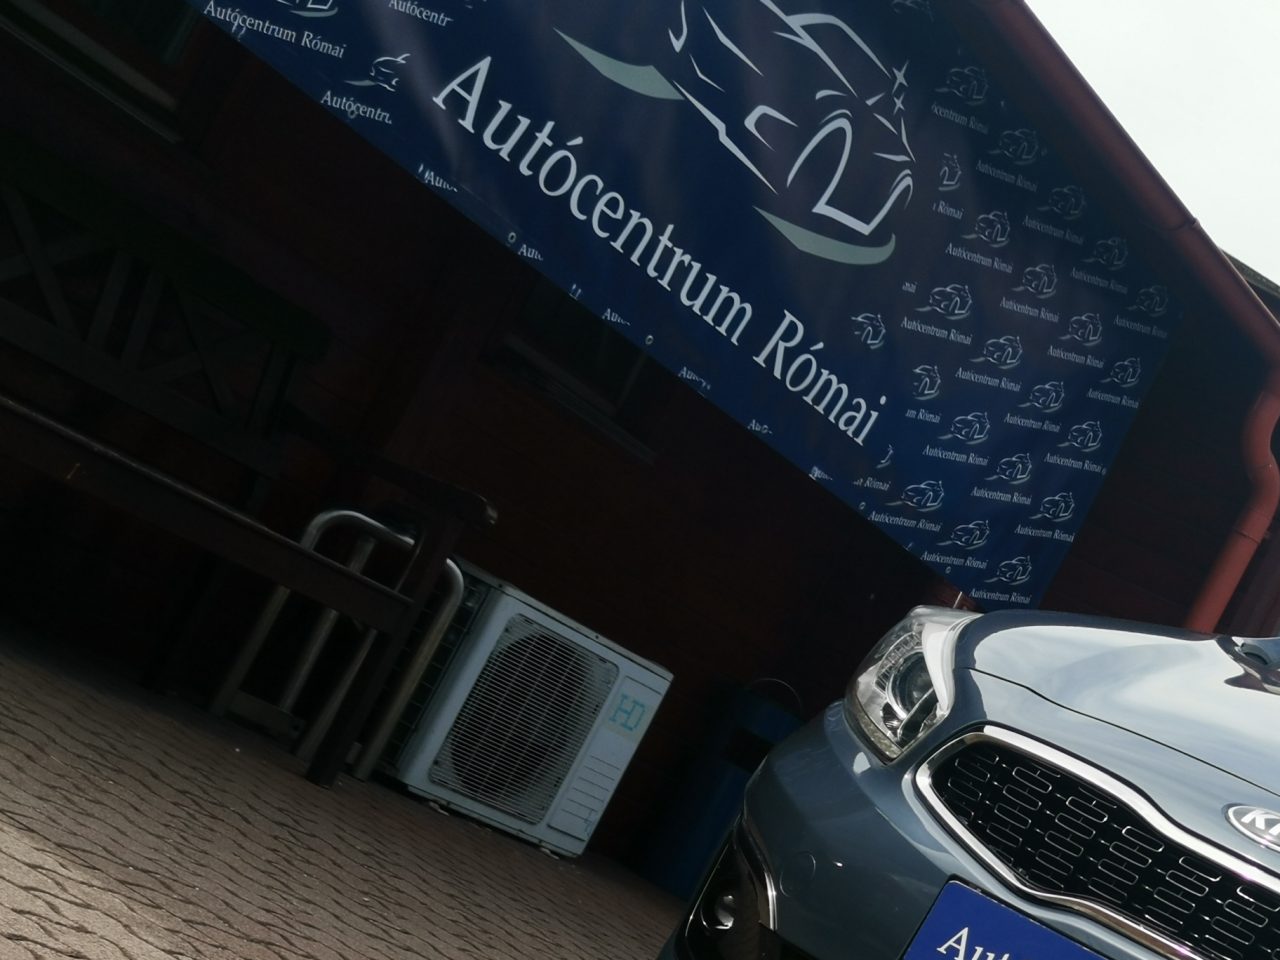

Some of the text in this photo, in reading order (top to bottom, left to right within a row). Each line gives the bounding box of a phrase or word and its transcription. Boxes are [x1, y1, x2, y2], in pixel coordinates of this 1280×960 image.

[203, 0, 347, 59] Autócentrum Római
[433, 56, 887, 446] Autócentrum Római
